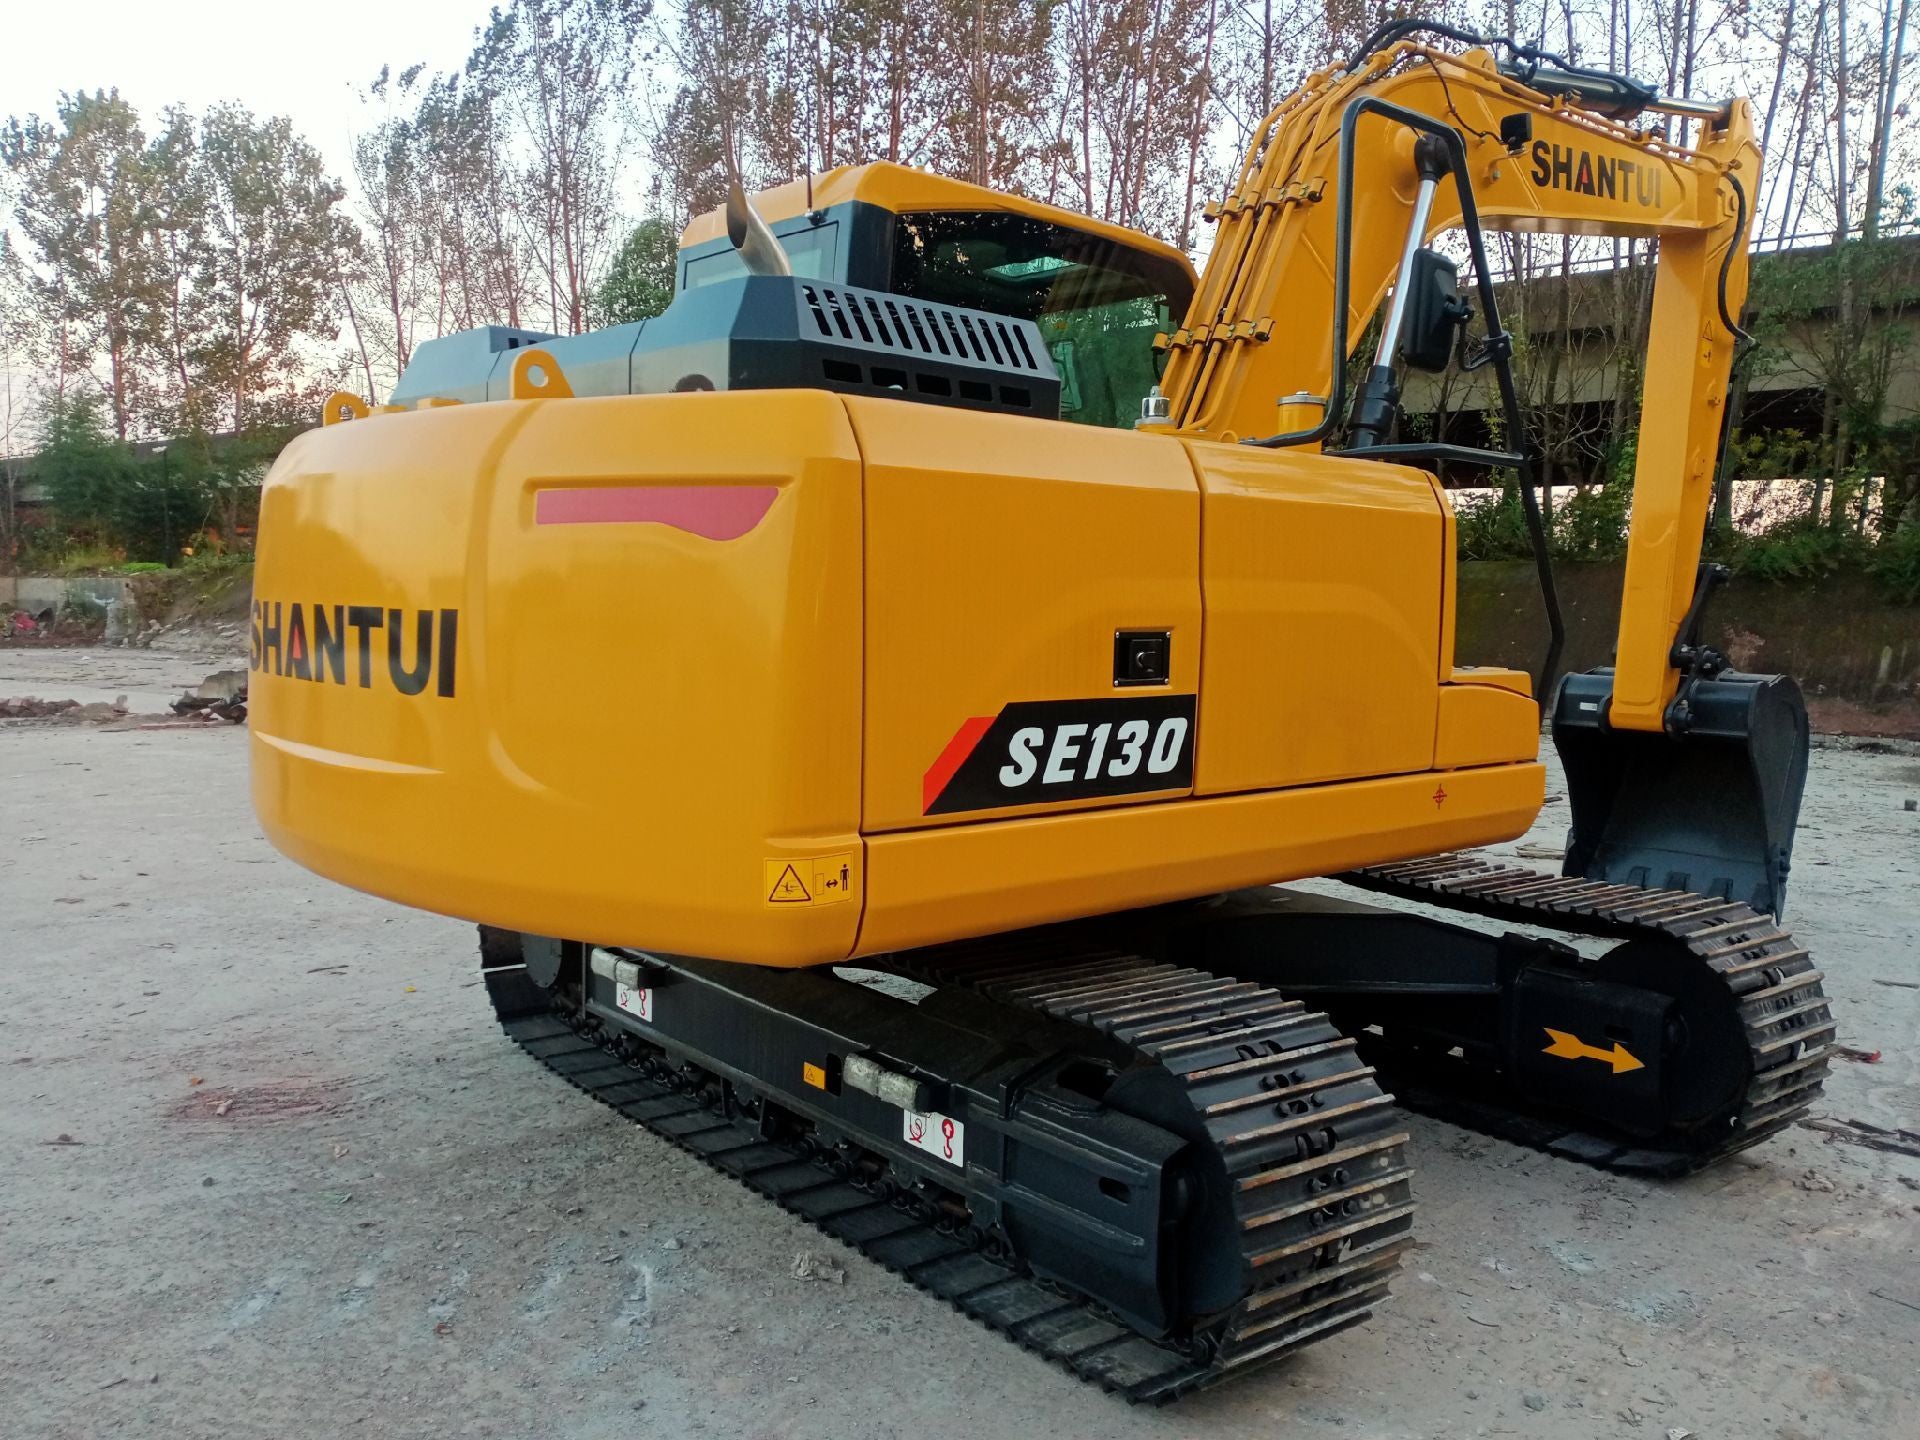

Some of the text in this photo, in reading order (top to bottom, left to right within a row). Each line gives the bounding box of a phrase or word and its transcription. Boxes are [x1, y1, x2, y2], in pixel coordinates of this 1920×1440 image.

[1531, 140, 1661, 208] SHANTUI
[249, 599, 458, 698] SHANTUI
[999, 717, 1188, 787] SE130
